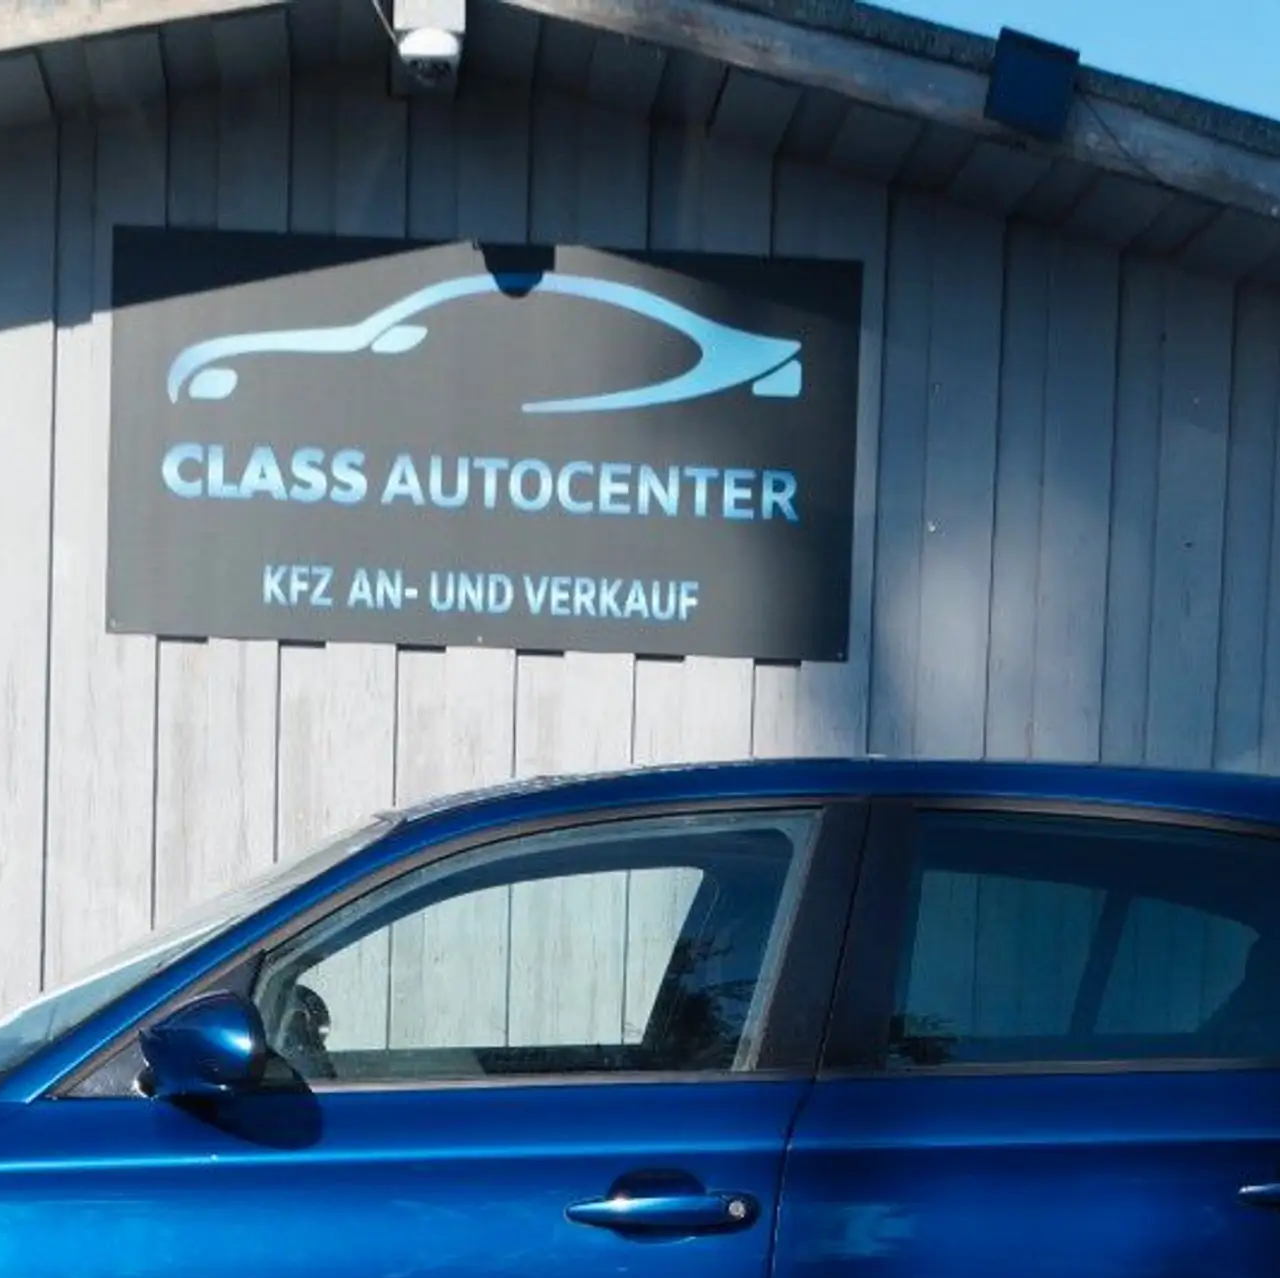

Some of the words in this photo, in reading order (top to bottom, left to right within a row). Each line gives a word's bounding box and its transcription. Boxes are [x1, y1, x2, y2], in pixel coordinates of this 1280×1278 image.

[161, 443, 367, 505] CLASS
[381, 454, 799, 521] AUTOCENTER
[262, 565, 334, 606] KFZ
[347, 568, 419, 609] AN-
[430, 572, 513, 614] UND
[525, 575, 699, 622] VERKAUF
